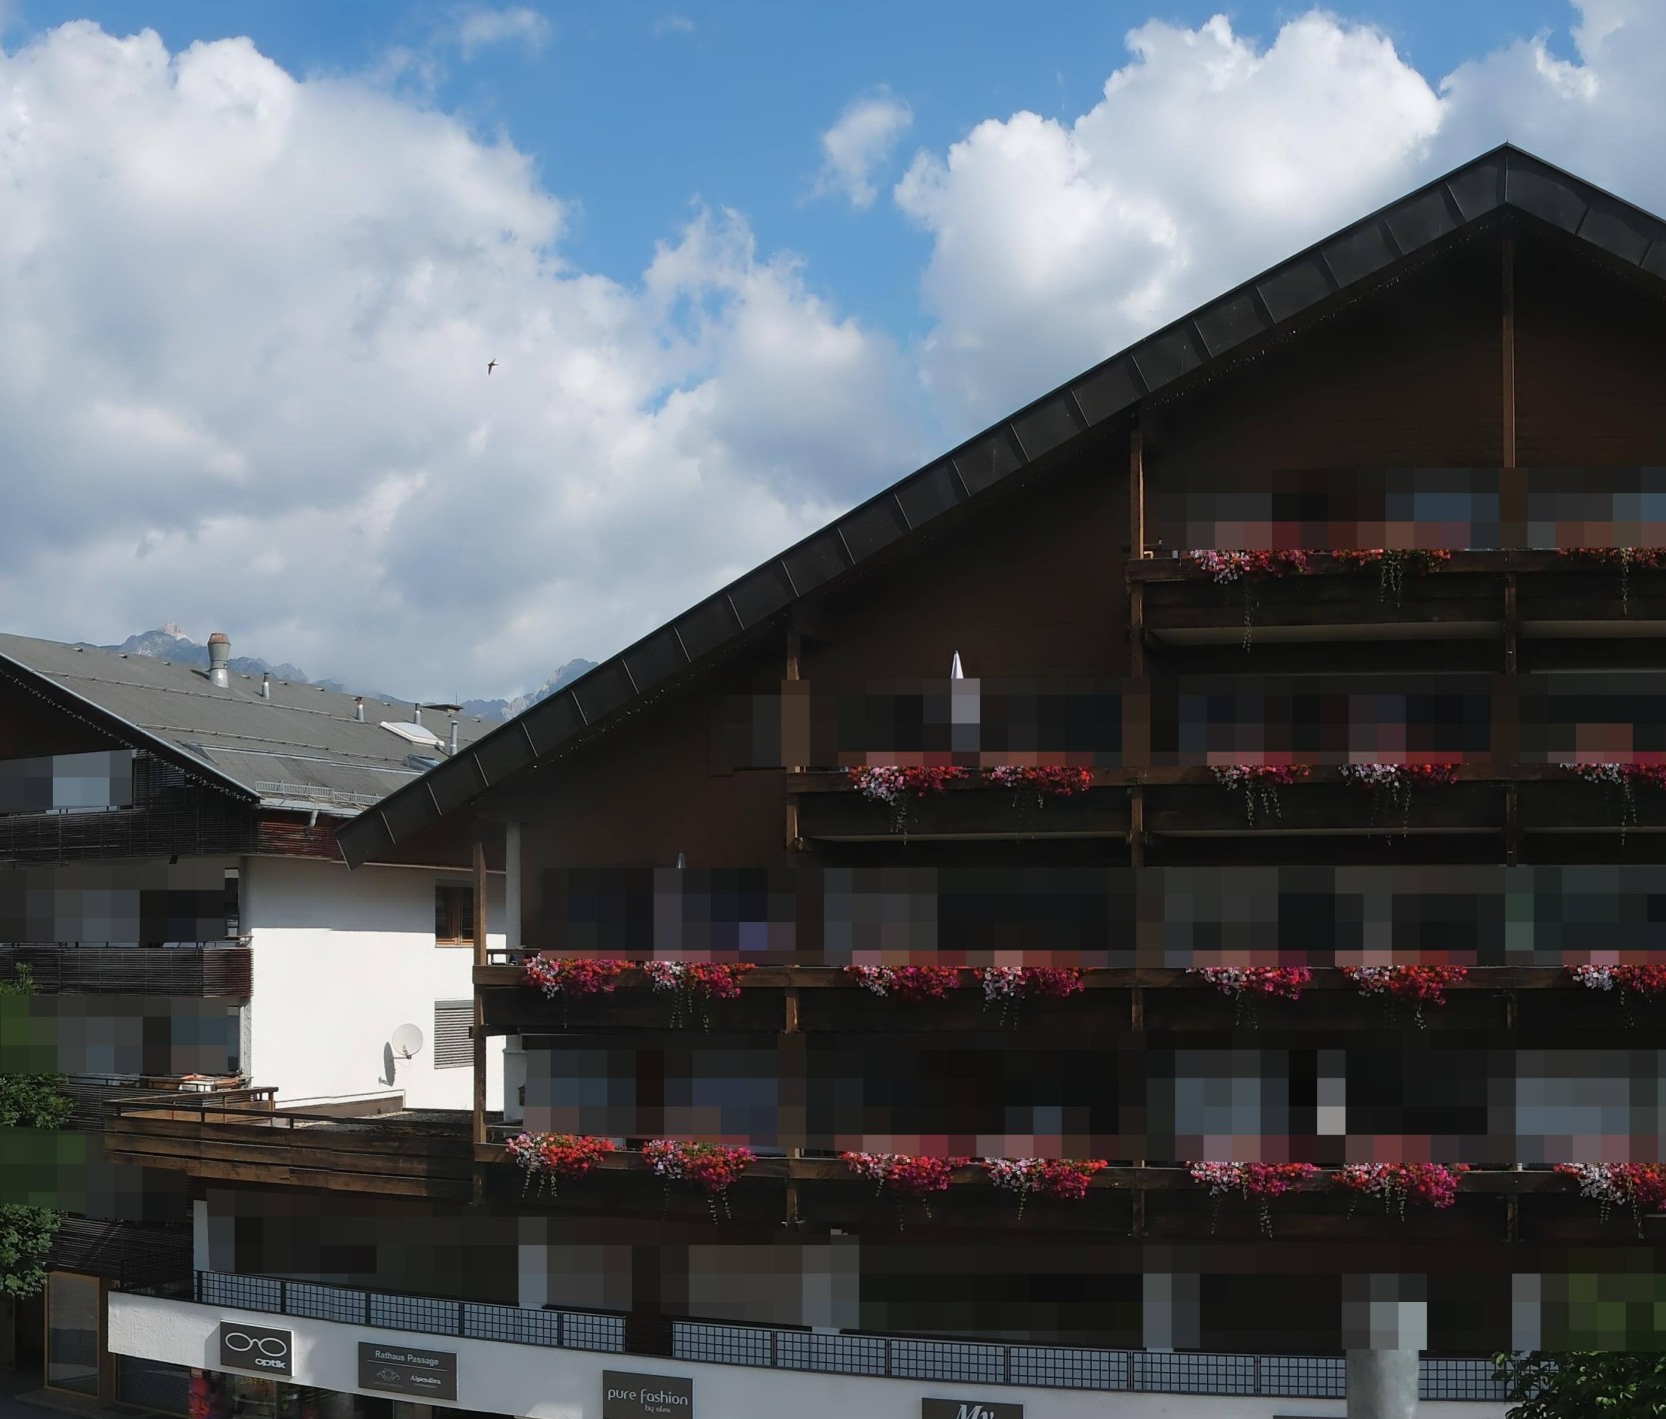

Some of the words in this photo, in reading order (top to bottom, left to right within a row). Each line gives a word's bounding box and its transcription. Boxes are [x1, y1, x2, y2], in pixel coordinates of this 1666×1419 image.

[254, 1357, 286, 1369] optik
[375, 1350, 405, 1361] Rathaus
[407, 1354, 439, 1367] Passage
[608, 1389, 637, 1401] pure
[640, 1388, 688, 1406] fashion
[645, 1404, 654, 1413] by
[656, 1406, 671, 1414] alex
